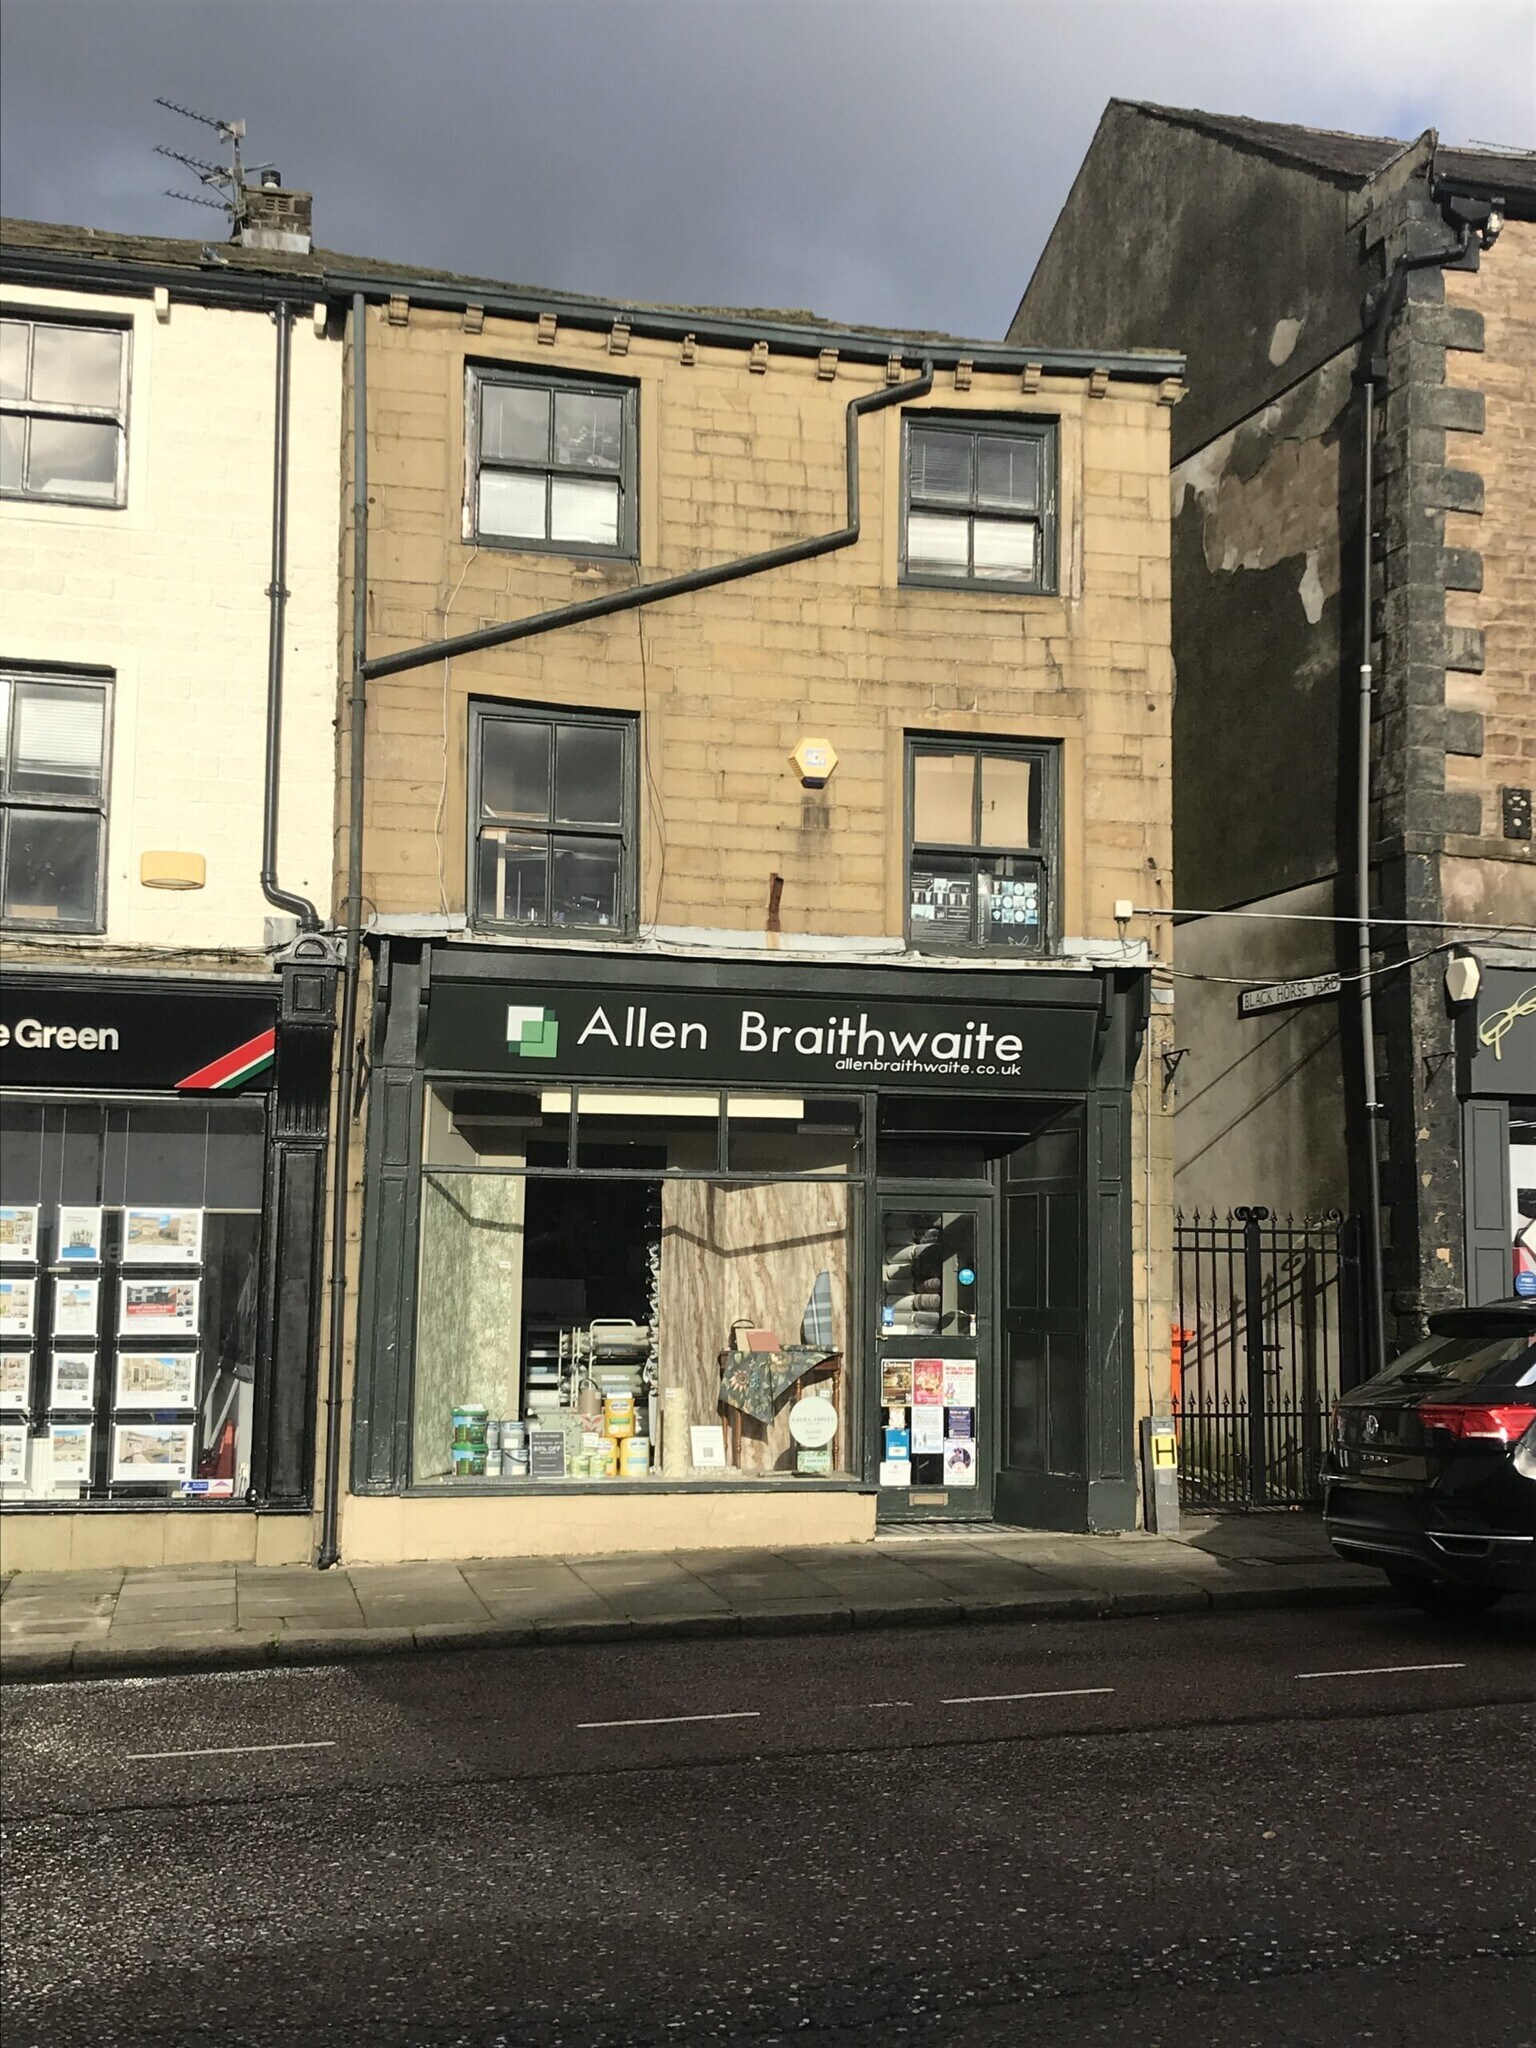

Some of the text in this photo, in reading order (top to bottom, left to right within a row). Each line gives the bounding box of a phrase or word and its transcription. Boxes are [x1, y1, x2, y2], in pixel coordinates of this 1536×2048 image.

[1244, 975, 1338, 1009] BLACK HORSE YARD
[15, 1018, 119, 1051] Green
[576, 1006, 1024, 1062] Allen Braithwaite
[835, 1057, 1022, 1076] allenbraithwaite.co.uk
[1154, 1438, 1176, 1465] H
